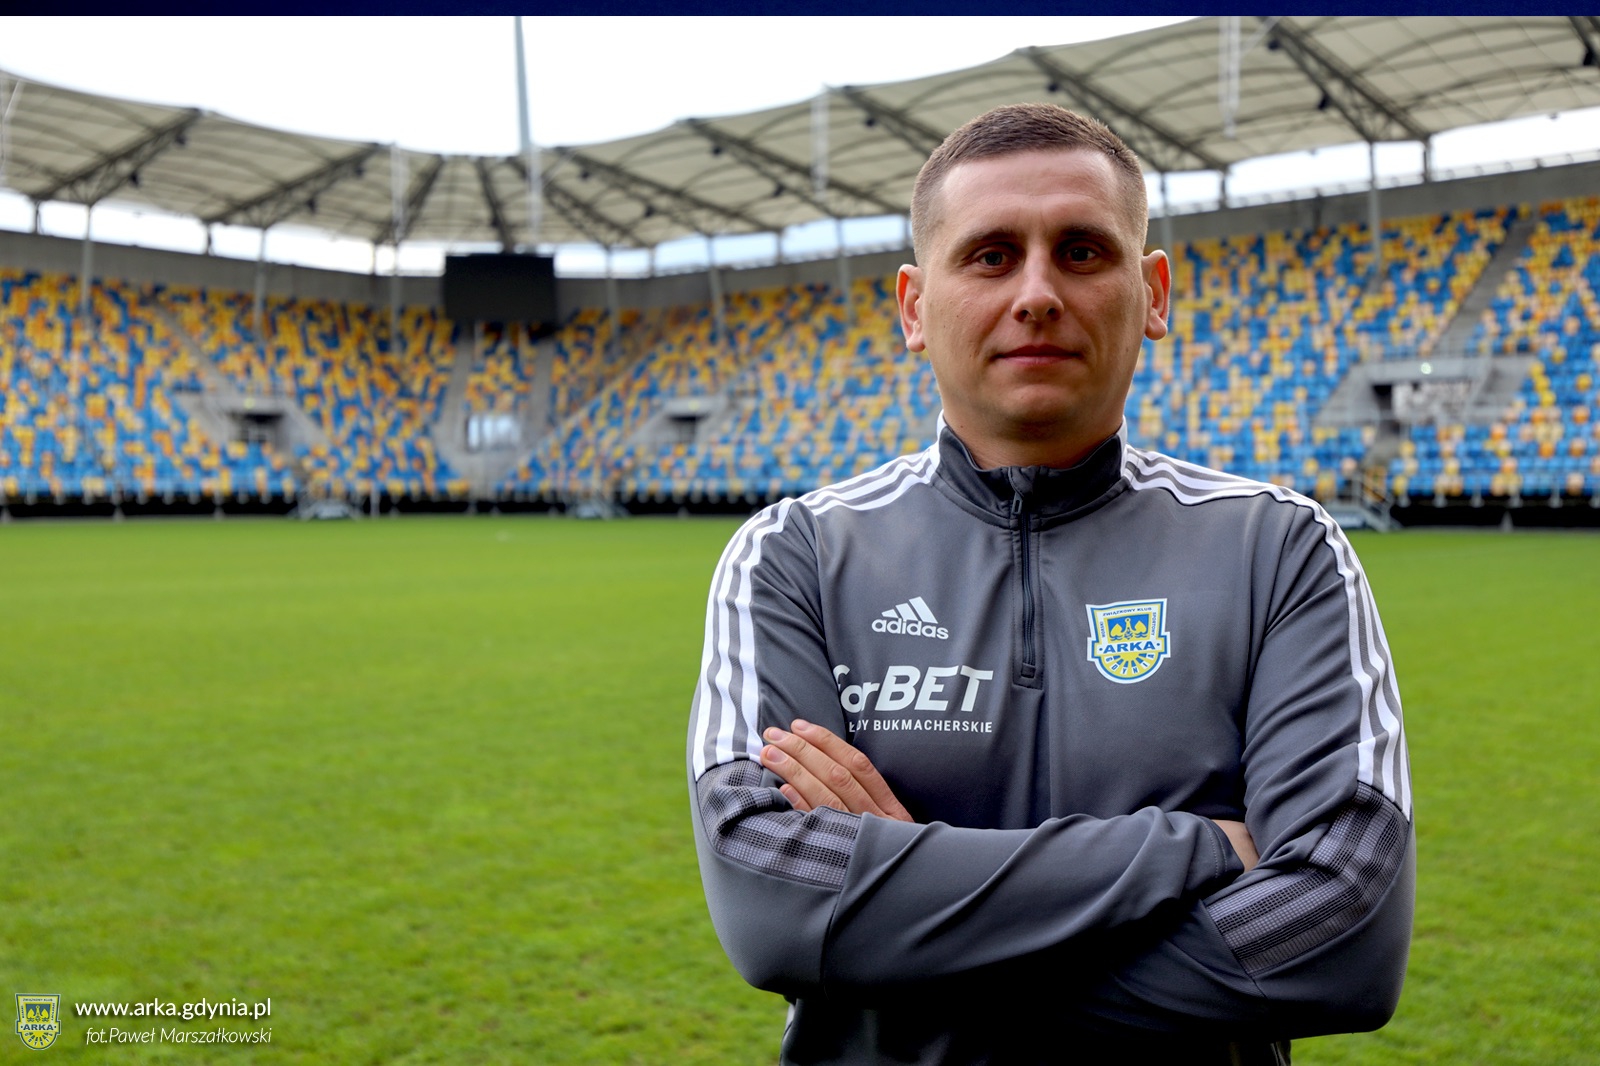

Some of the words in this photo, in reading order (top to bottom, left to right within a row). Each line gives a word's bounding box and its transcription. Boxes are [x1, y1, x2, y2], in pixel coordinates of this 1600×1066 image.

[871, 617, 949, 640] adidas
[1103, 641, 1156, 654] ARKA
[873, 719, 993, 733] BUKMACHERSKIE
